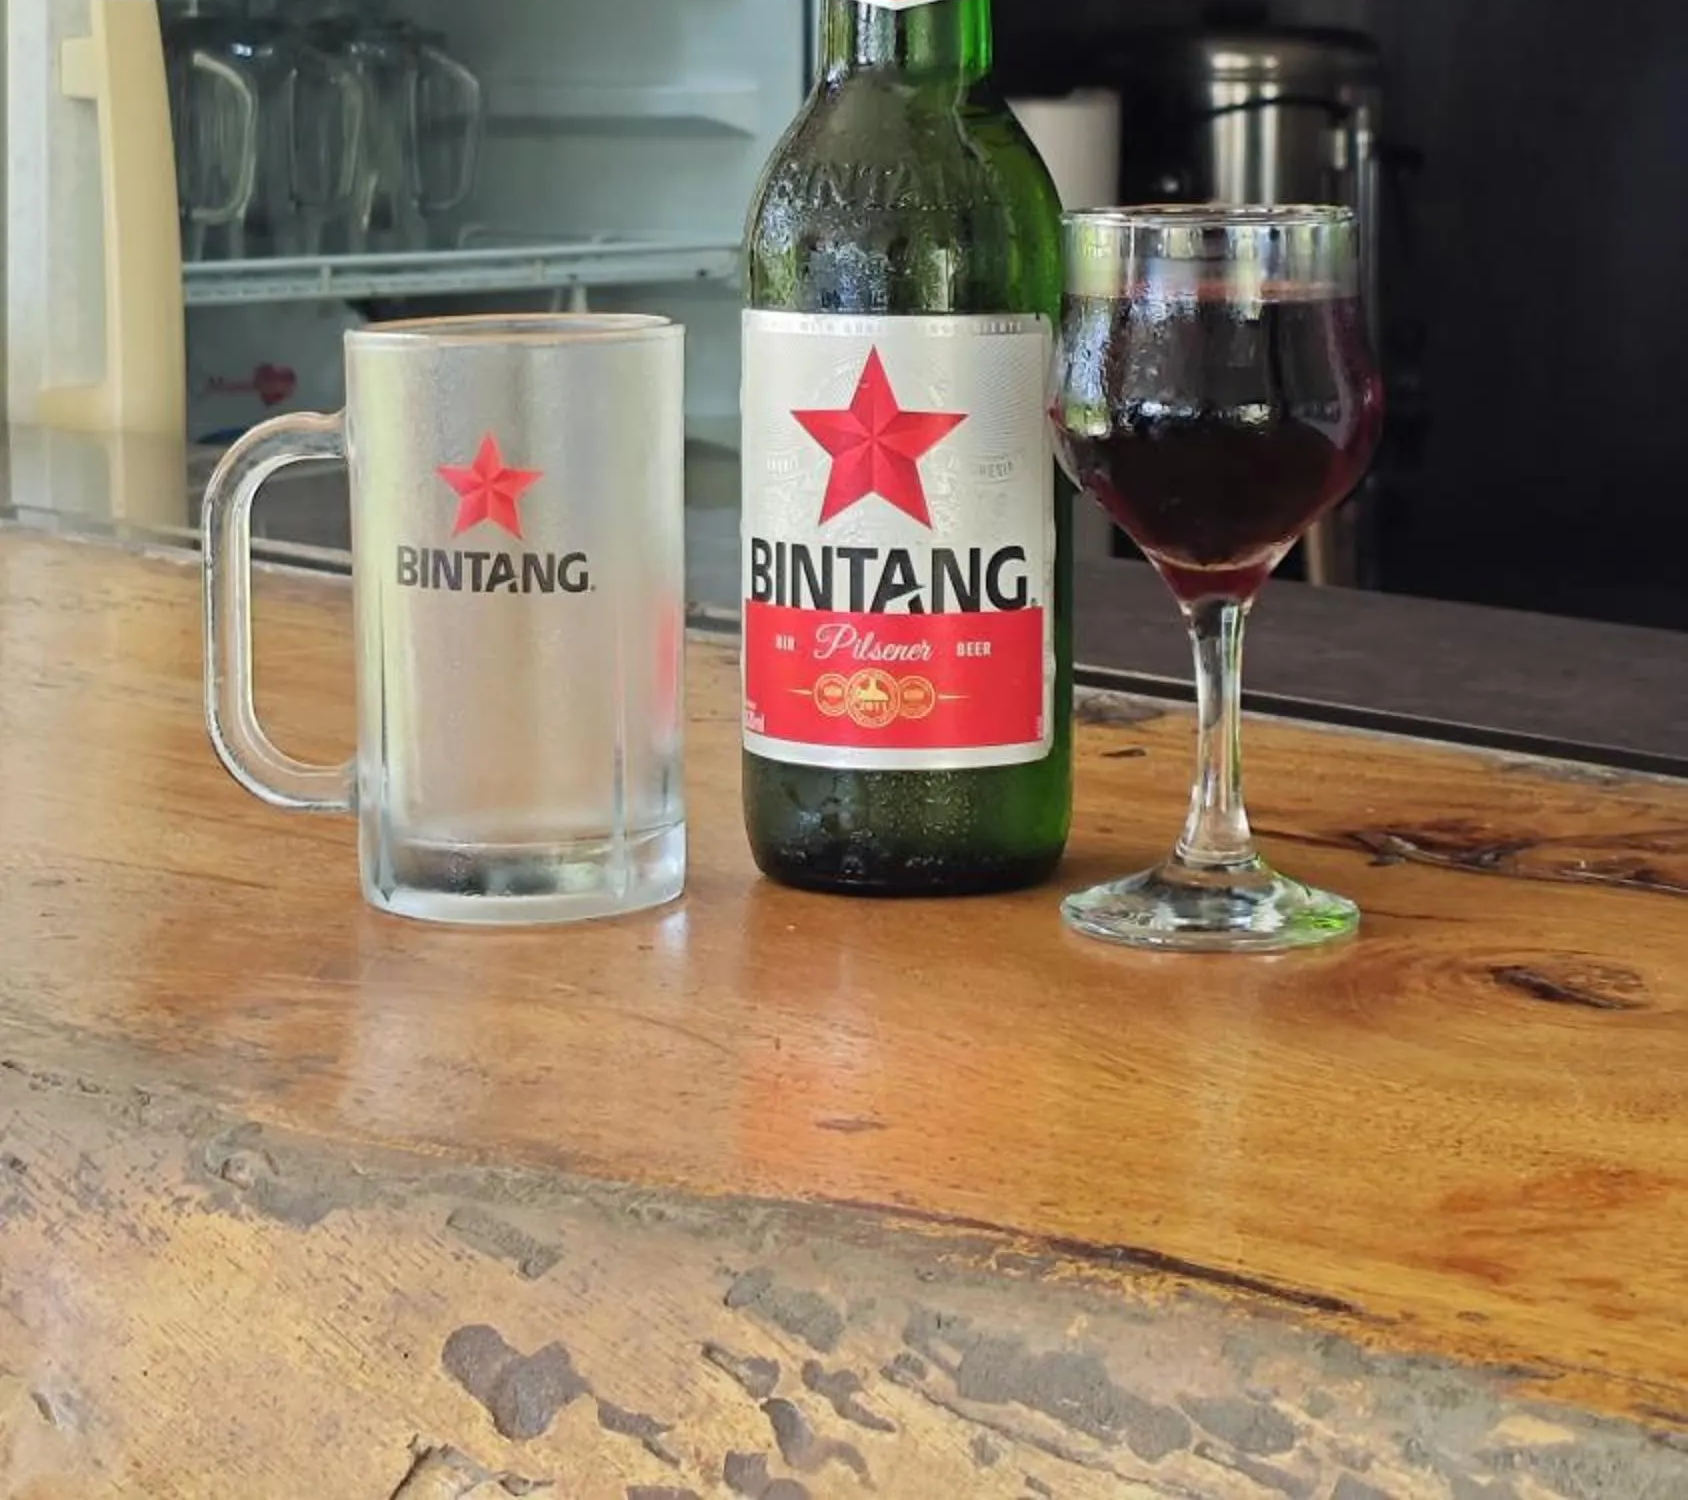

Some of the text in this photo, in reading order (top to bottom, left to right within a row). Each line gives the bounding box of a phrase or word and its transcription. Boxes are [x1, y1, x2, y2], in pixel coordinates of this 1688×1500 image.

[396, 545, 590, 593] BINTANG
[750, 536, 1028, 615] BINTANG
[813, 622, 935, 662] Pilsener
[955, 641, 992, 658] BEER
